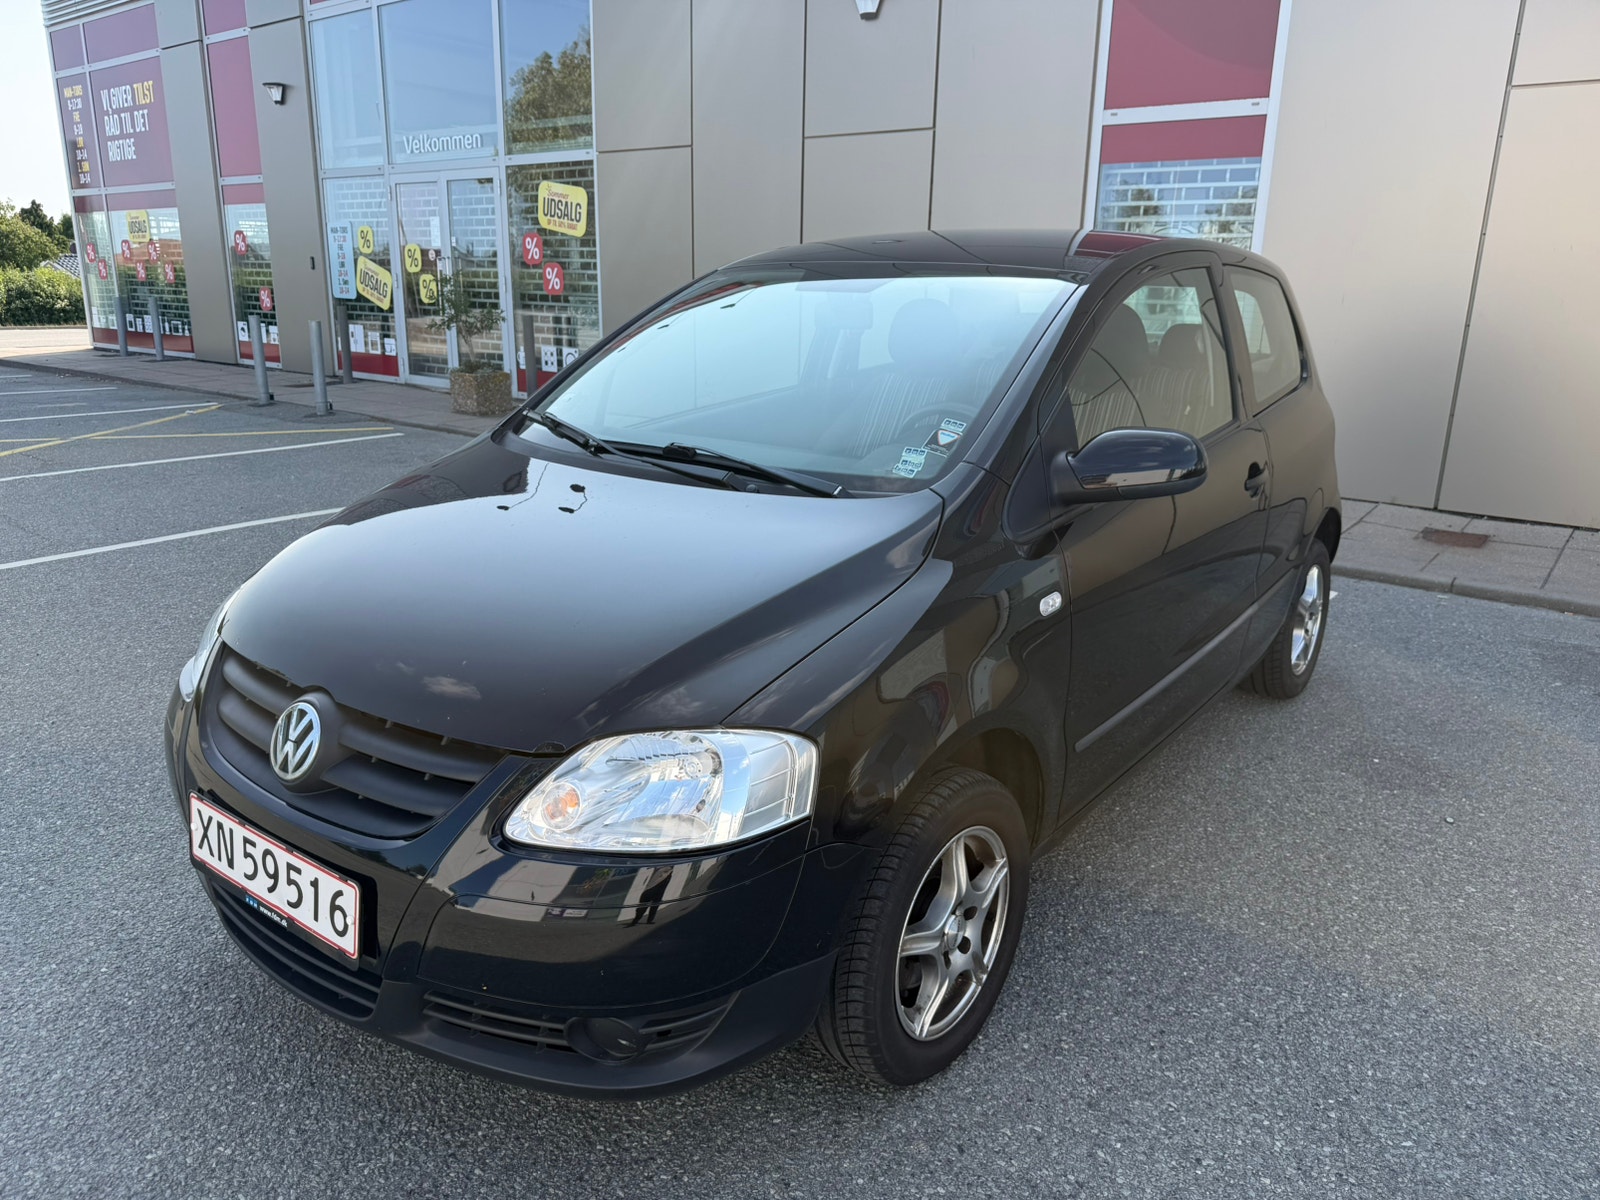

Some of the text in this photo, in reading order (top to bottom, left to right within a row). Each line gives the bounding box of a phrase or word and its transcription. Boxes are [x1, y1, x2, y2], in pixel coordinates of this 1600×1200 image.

[100, 81, 154, 111] VI GIVER TILST
[104, 109, 149, 136] RÅD TIL DET
[107, 138, 136, 162] RIGTIGE
[403, 133, 482, 154] Velkommen
[543, 197, 582, 223] UDSALG
[360, 268, 388, 298] UDSALG
